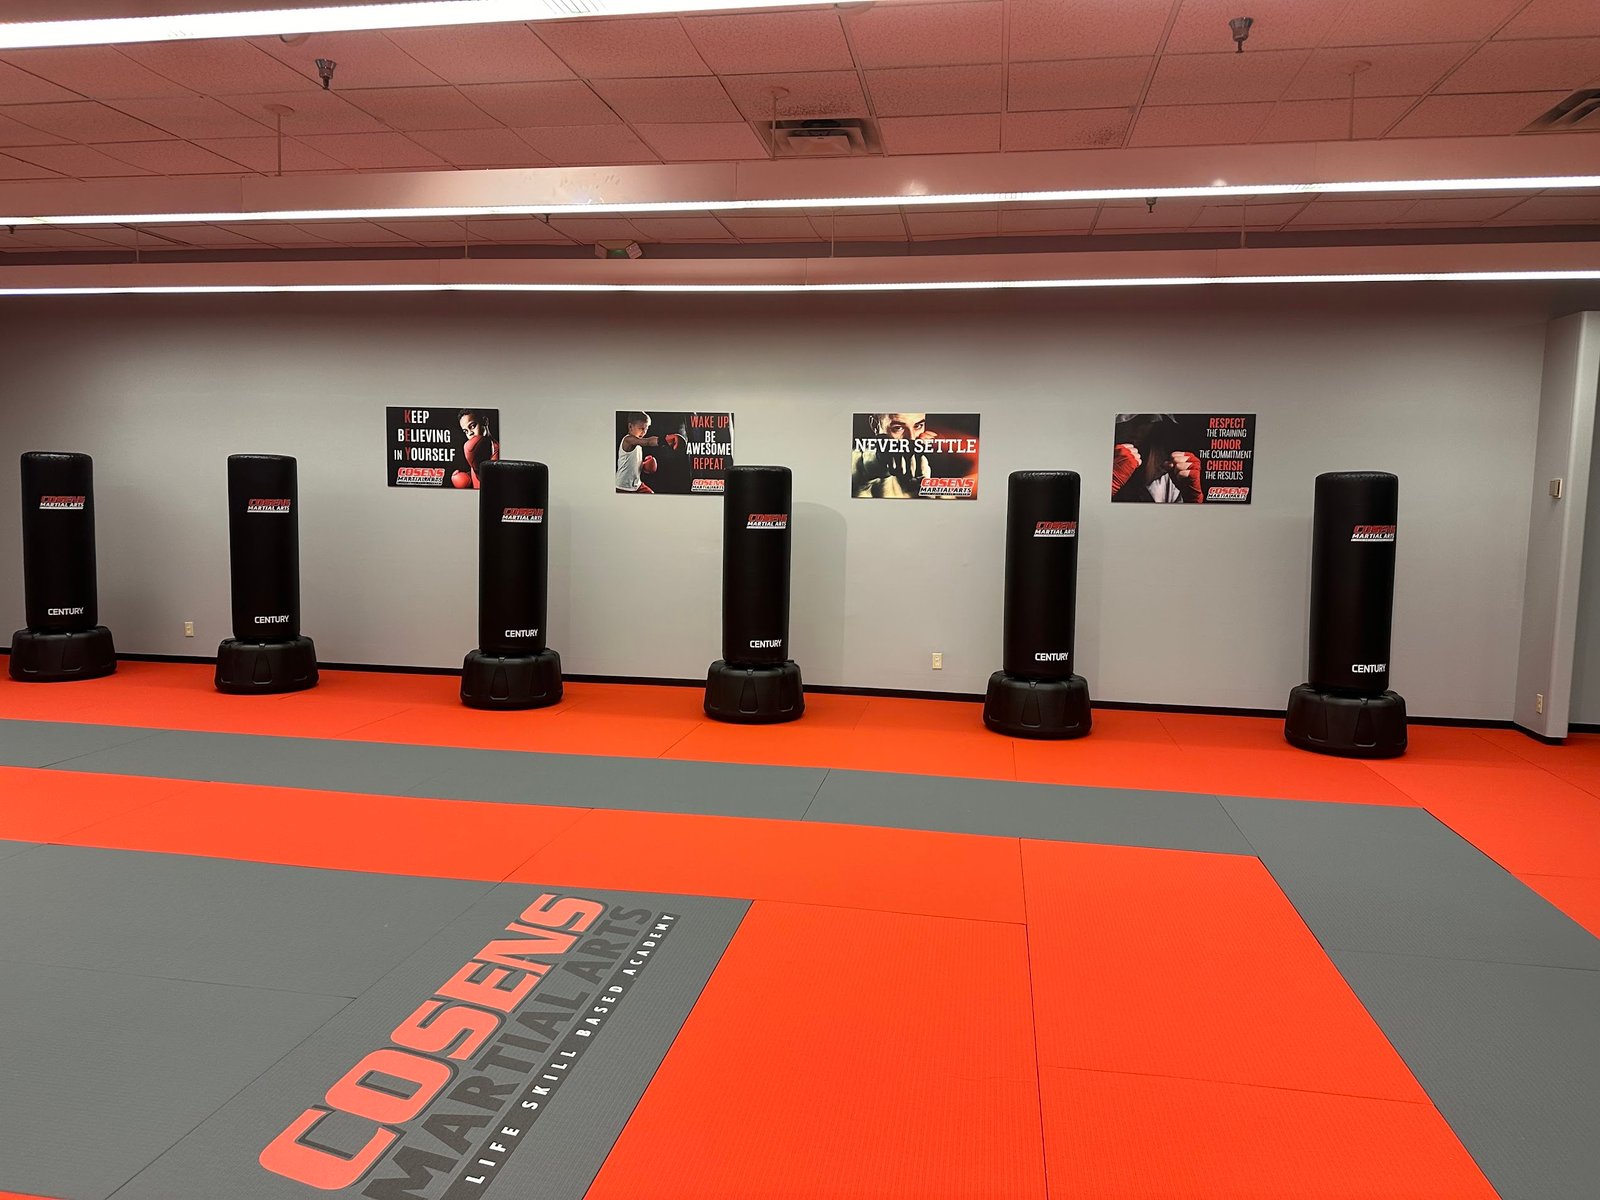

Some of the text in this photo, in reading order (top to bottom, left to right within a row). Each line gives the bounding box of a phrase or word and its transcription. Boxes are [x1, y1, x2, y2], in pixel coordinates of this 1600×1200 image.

[404, 409, 430, 424] KEEP
[690, 415, 714, 428] WAKE
[1209, 418, 1245, 428] RESPECT
[397, 428, 451, 443] BELIEVING
[704, 431, 716, 443] BE
[1206, 429, 1247, 438] THE TRAINING
[686, 442, 731, 456] AWESOME
[855, 438, 977, 453] NEVER SETTLE
[1210, 439, 1241, 450] HONOR
[394, 447, 456, 462] IN YOURSELF
[1199, 450, 1252, 459] THE COMMITMENT
[693, 457, 726, 470] REPEAT.
[1206, 460, 1243, 471] CHERISH
[398, 467, 445, 477] COSENS
[1205, 471, 1244, 480] THE RESULTS
[921, 478, 974, 487] COSENS
[47, 606, 84, 616] CENTURY
[254, 614, 289, 624] CENTURY
[505, 628, 538, 638] CENTURY
[749, 639, 782, 648] CENTURY
[1034, 652, 1069, 661] CENTURY
[1351, 664, 1386, 674] CENTURY
[258, 893, 608, 1191] COSENS
[360, 905, 653, 1200] MARTIAL ARTS
[465, 914, 675, 1185] LIFE SKILL BASED ACADEMY
